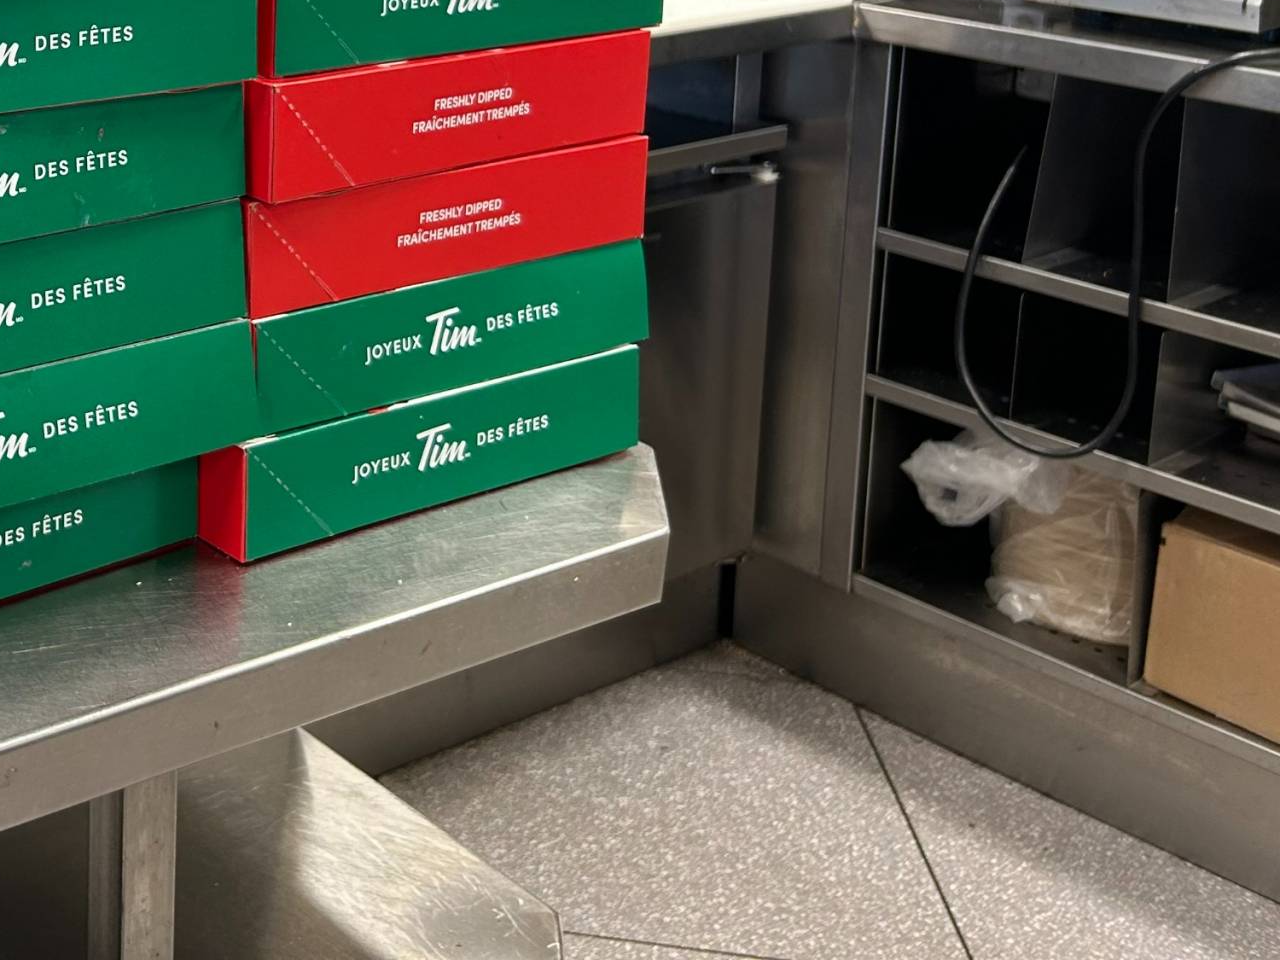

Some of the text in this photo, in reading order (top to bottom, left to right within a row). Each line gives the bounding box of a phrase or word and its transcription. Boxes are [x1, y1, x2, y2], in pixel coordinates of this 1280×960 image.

[35, 32, 71, 52] DES
[78, 24, 134, 47] FÊTES
[434, 87, 513, 111] FRESHLY DIPPED
[412, 100, 531, 135] FRAÎCHEMENT TREMPÉS
[34, 159, 69, 181] DES
[75, 149, 128, 173] FÊTES
[397, 210, 522, 248] FRAÎCHEMENT TREMPÉS
[419, 198, 503, 225] FRESHLY DIPPED
[31, 287, 66, 310] DES
[72, 275, 126, 301] FÊTES
[364, 302, 559, 366] JOYEUX Tim DES FÊTES
[43, 415, 79, 439] DES
[84, 400, 139, 429] FÊTES
[351, 414, 549, 485] JOYEUX Tim DES FÊTES
[32, 508, 84, 538] FÊTES
